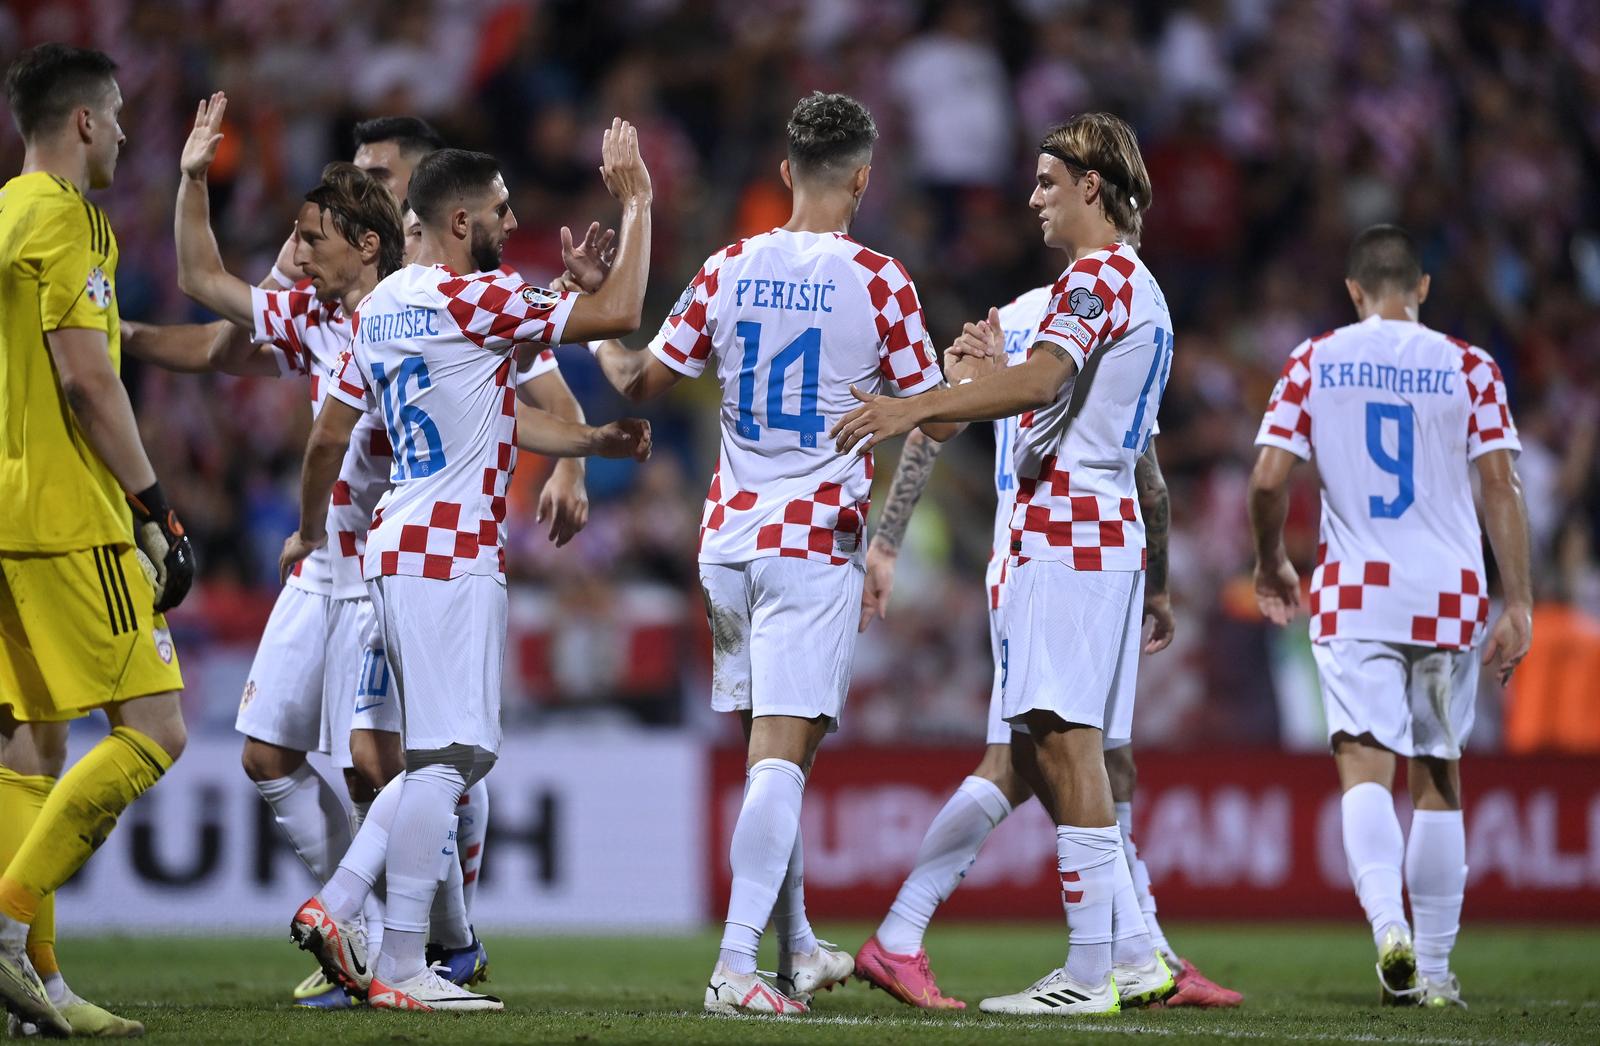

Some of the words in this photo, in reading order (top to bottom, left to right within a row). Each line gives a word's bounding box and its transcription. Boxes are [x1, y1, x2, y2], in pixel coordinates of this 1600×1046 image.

[370, 356, 447, 480] 16
[736, 321, 825, 448] 14
[1318, 362, 1455, 395] KRAMARIĆ
[1366, 402, 1415, 519] 9
[358, 649, 389, 696] 10
